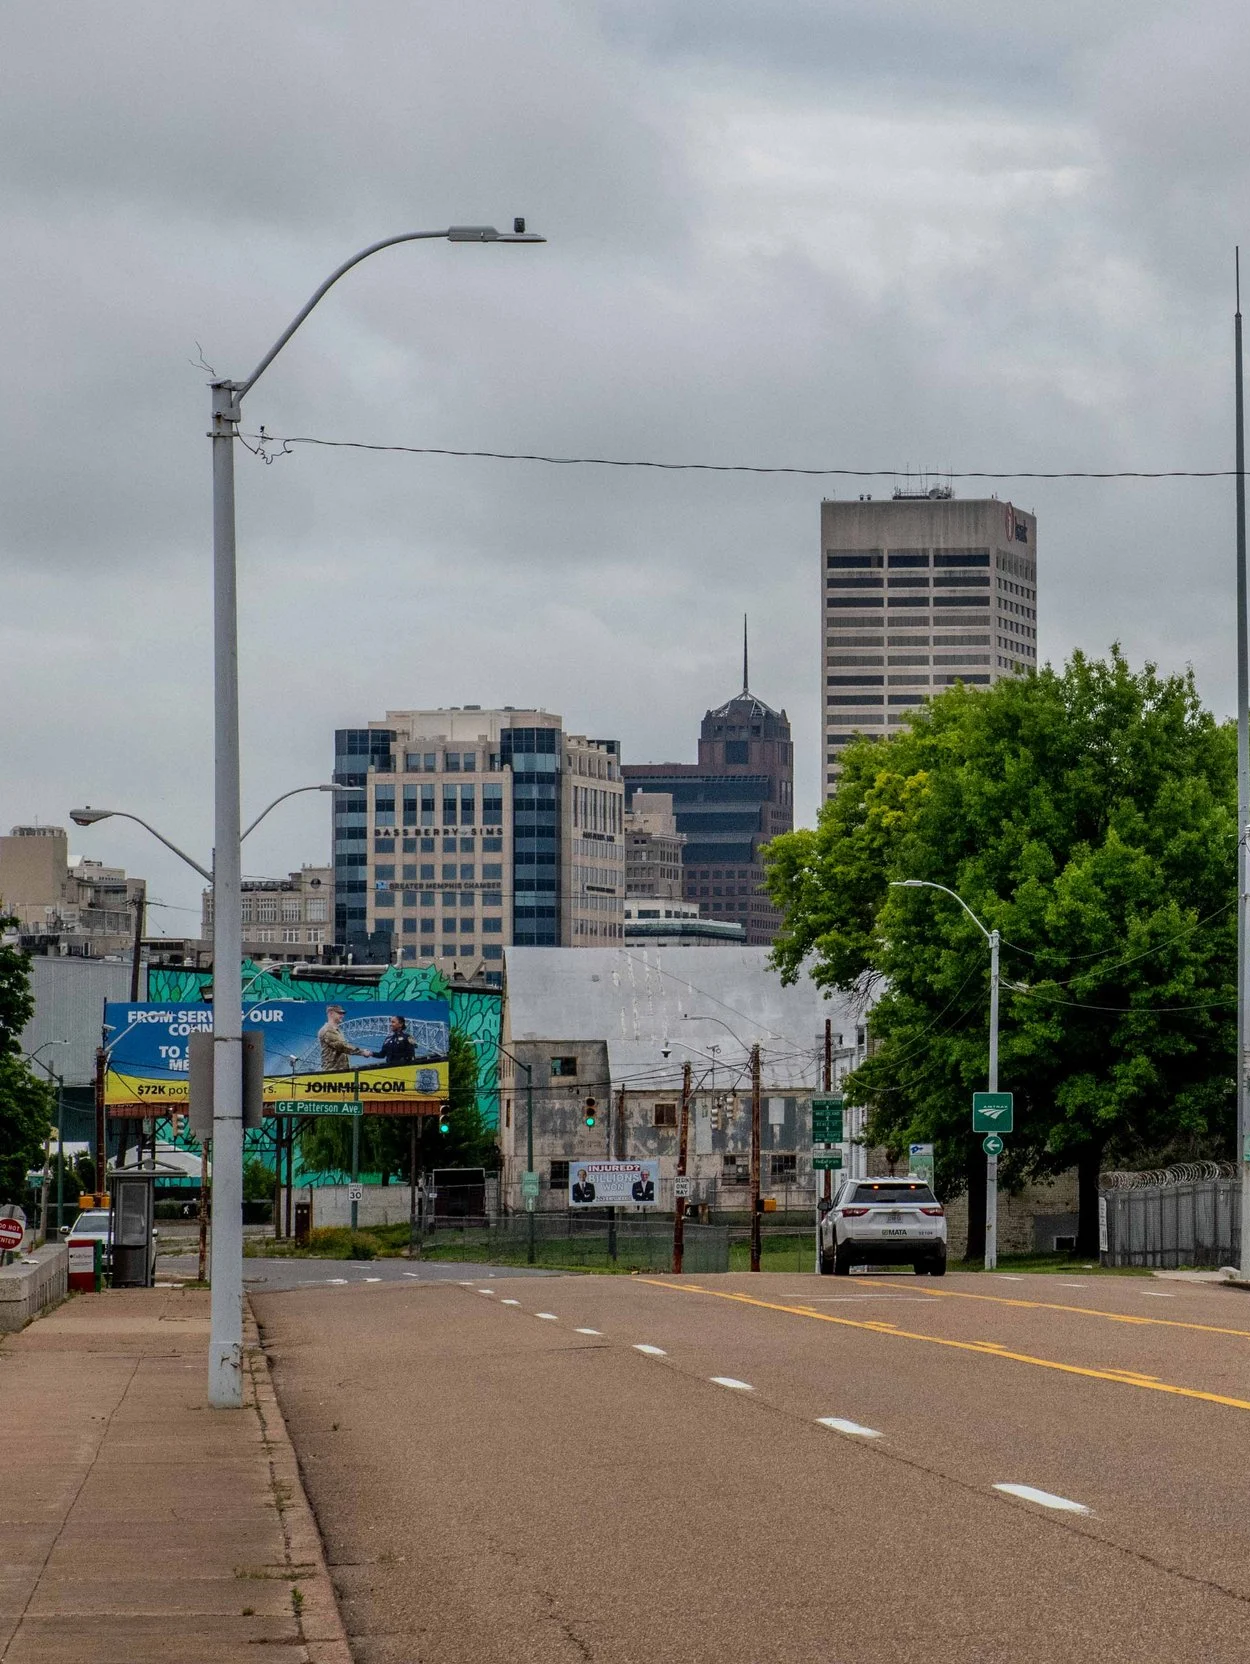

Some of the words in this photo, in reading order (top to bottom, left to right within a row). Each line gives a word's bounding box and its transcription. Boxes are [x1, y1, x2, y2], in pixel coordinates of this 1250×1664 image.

[374, 828, 409, 837] BASS
[414, 827, 458, 837] BERRY
[471, 827, 503, 836] SIMS
[389, 882, 425, 890] GREATER
[127, 1010, 173, 1023] FROM
[251, 1009, 283, 1022] OUR
[159, 1046, 180, 1058] TO
[137, 1085, 166, 1096] $72K
[278, 1102, 294, 1112] GE
[297, 1102, 339, 1113] Patterson
[341, 1103, 361, 1113] Ave.
[588, 1164, 640, 1172] INJURED?
[588, 1173, 640, 1183] BILLIONS
[349, 1191, 361, 1199] 30
